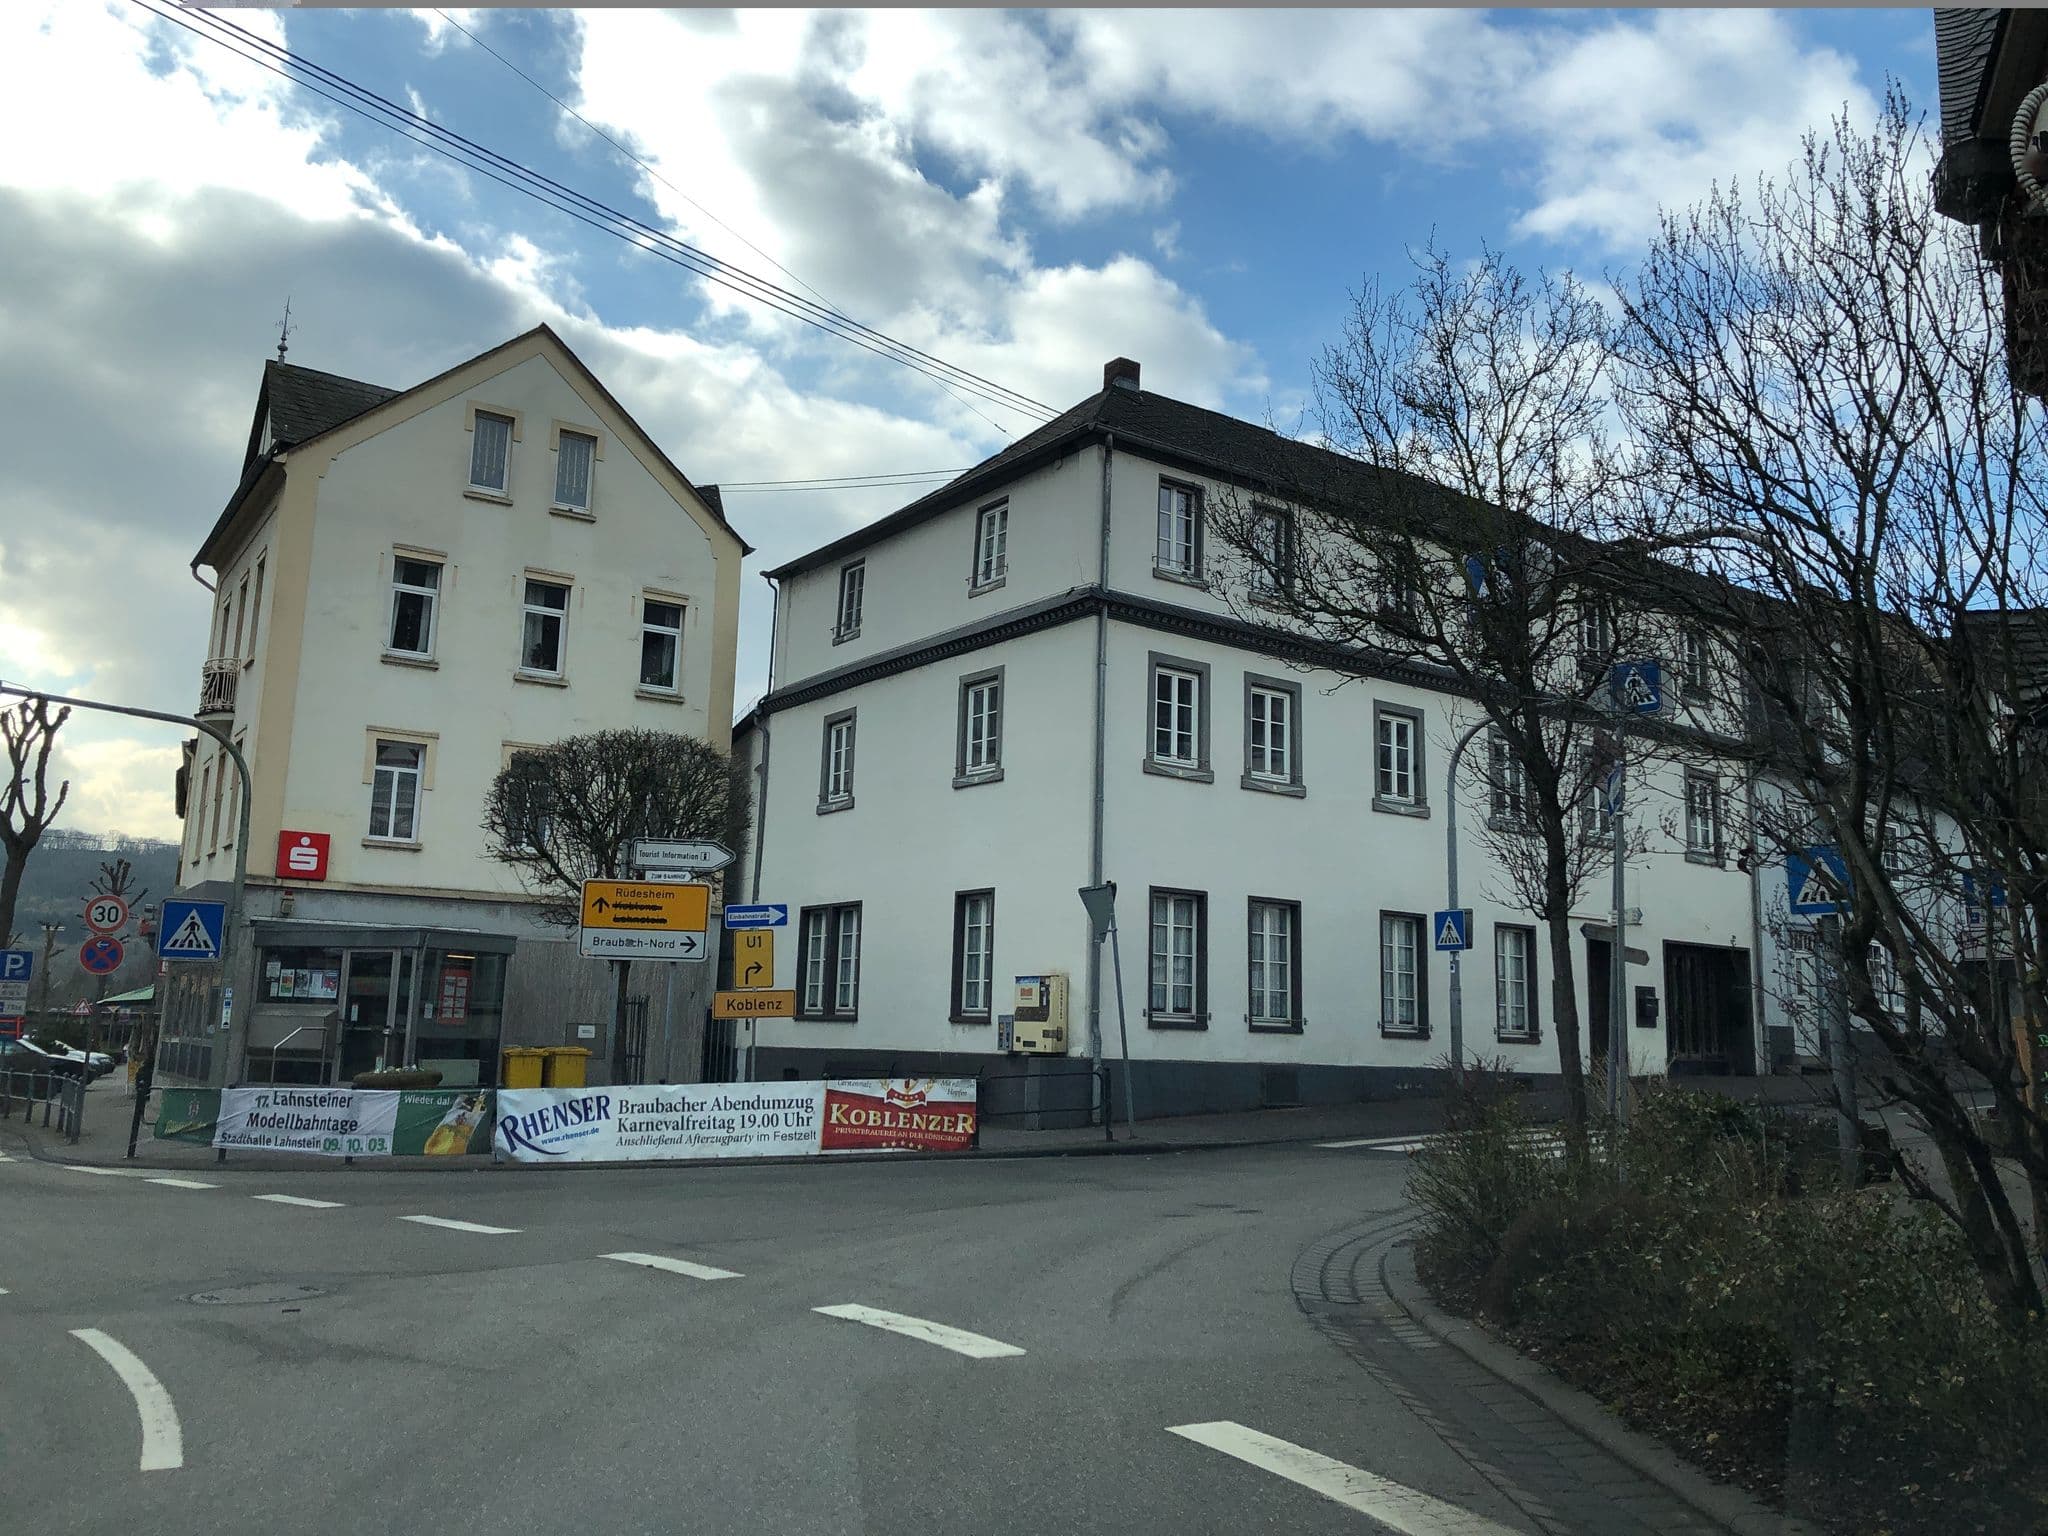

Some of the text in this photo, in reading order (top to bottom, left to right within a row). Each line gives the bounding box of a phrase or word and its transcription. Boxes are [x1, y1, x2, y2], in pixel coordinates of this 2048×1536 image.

[639, 849, 660, 859] Tourist
[662, 850, 699, 861] Information
[94, 905, 119, 923] 30
[729, 912, 771, 921] Einbahnstraße
[746, 935, 762, 948] U1
[4, 953, 24, 977] P
[726, 999, 783, 1012] Koblenz
[255, 1090, 353, 1108] 17. Lahnsteiner
[404, 1095, 433, 1105] Wieder
[618, 1094, 814, 1114] Braubacher Abendumzug
[246, 1112, 358, 1135] Modellbahntage
[617, 1112, 813, 1133] Karnevalfreitag 19.00 Uhr
[221, 1132, 388, 1152] Stadthalle Lahnstein 09. 10. 03.
[541, 1127, 600, 1146] www.rhenser.de
[616, 1130, 817, 1147] Anschließend Afterzugparty im Festzelt
